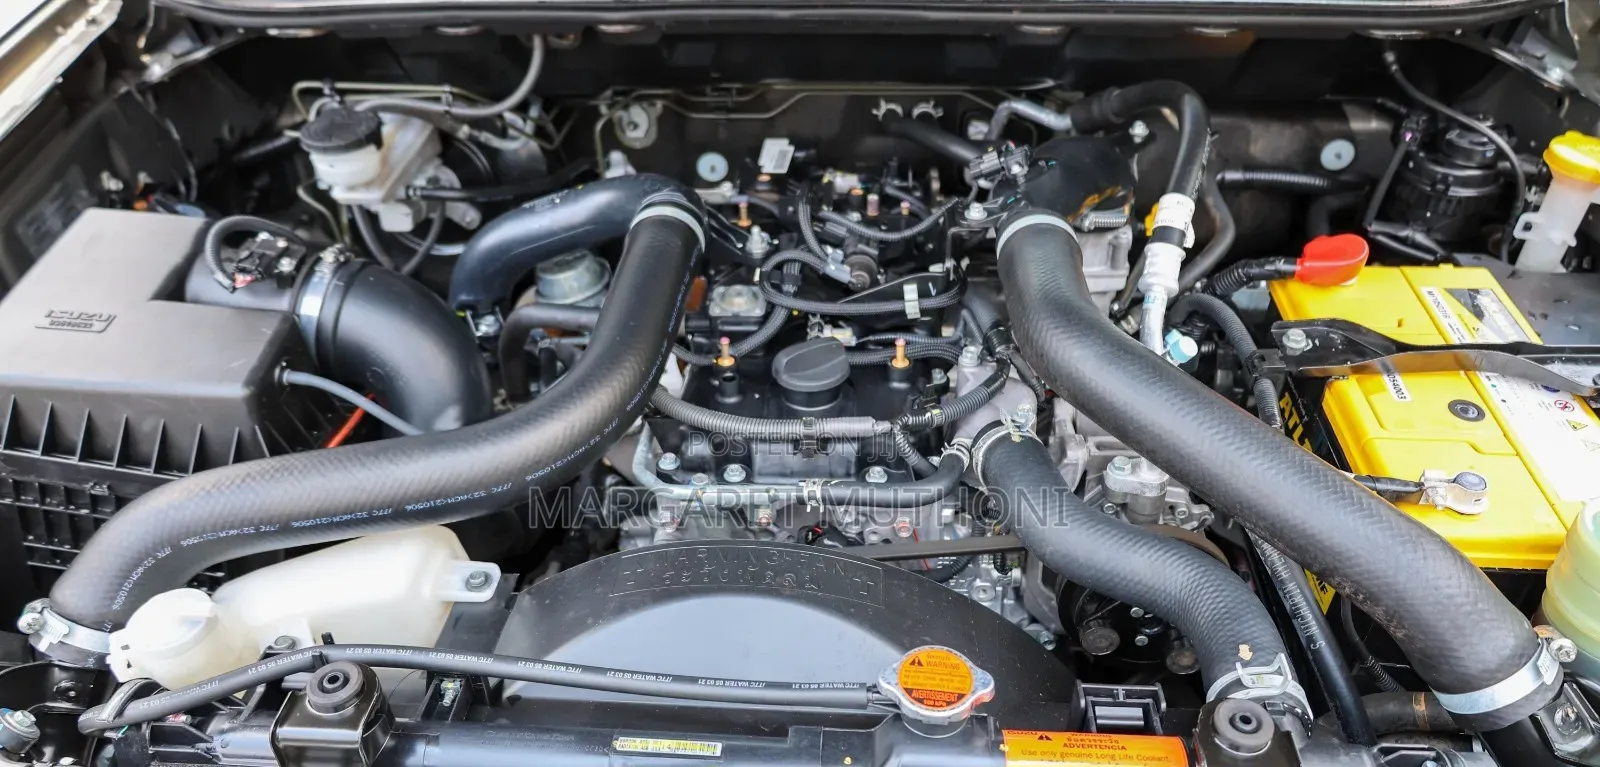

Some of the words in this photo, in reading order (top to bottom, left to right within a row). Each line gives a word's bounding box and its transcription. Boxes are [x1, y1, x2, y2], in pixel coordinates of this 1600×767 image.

[44, 310, 112, 322] ISUZU
[454, 654, 477, 663] WATER
[543, 663, 566, 672] WATER
[926, 660, 960, 671] WARNING
[632, 673, 656, 681] WATER
[1063, 743, 1127, 751] ADVERTENCIA
[1040, 750, 1058, 759] only
[1060, 752, 1093, 760] genuine
[1095, 753, 1117, 761] Long
